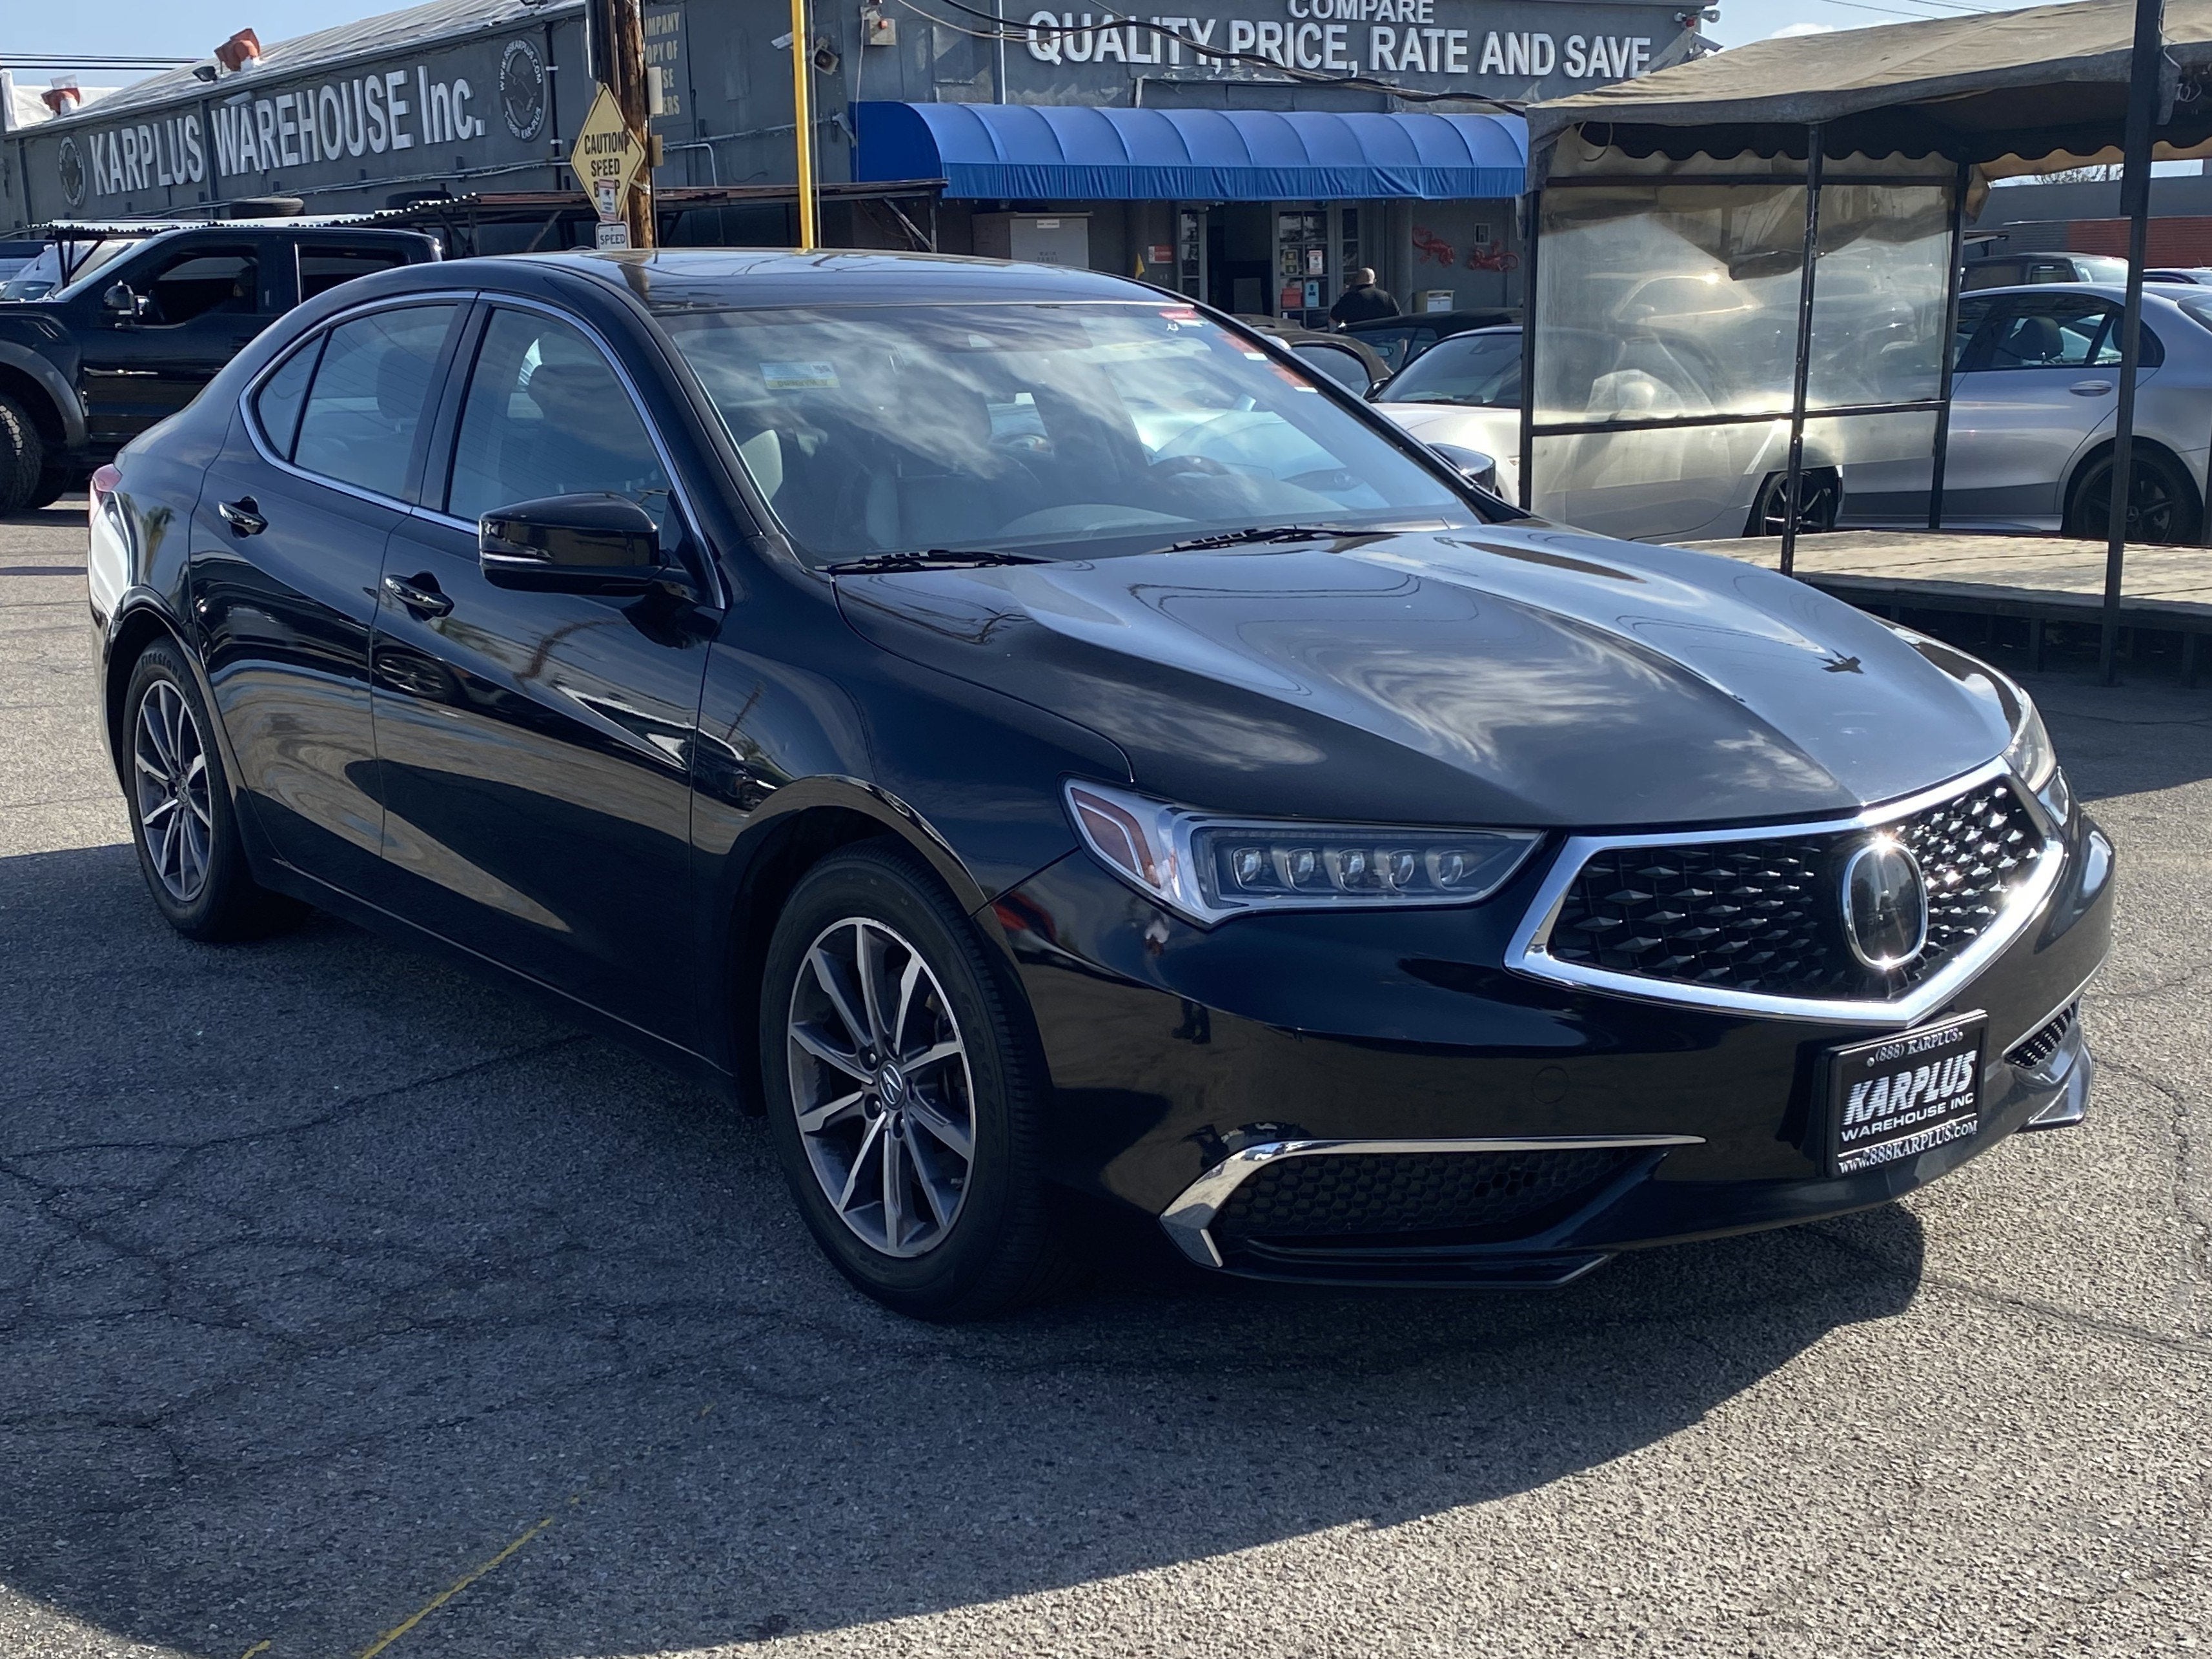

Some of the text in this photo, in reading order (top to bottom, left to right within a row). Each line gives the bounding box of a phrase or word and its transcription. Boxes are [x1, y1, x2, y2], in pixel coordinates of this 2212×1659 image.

[1288, 0, 1434, 24] COMPARE
[646, 40, 678, 64] OPY OF
[1230, 20, 1357, 77] PRICE,
[1369, 26, 1468, 74] RATE
[1479, 31, 1555, 76] AND
[1563, 34, 1650, 78] SAVE
[89, 115, 202, 196] KARPLUS
[211, 70, 414, 176] WAREHOUSE
[418, 65, 485, 144] Inc.
[585, 131, 624, 155] CAUTION
[591, 158, 620, 177] SPEED
[593, 180, 620, 198] BP
[600, 234, 625, 245] SPEED
[1875, 1028, 1958, 1062] (888) KARPLUS
[1842, 1050, 1977, 1125] KARPLUS
[1841, 1093, 1974, 1142] WAREHOUSE INC
